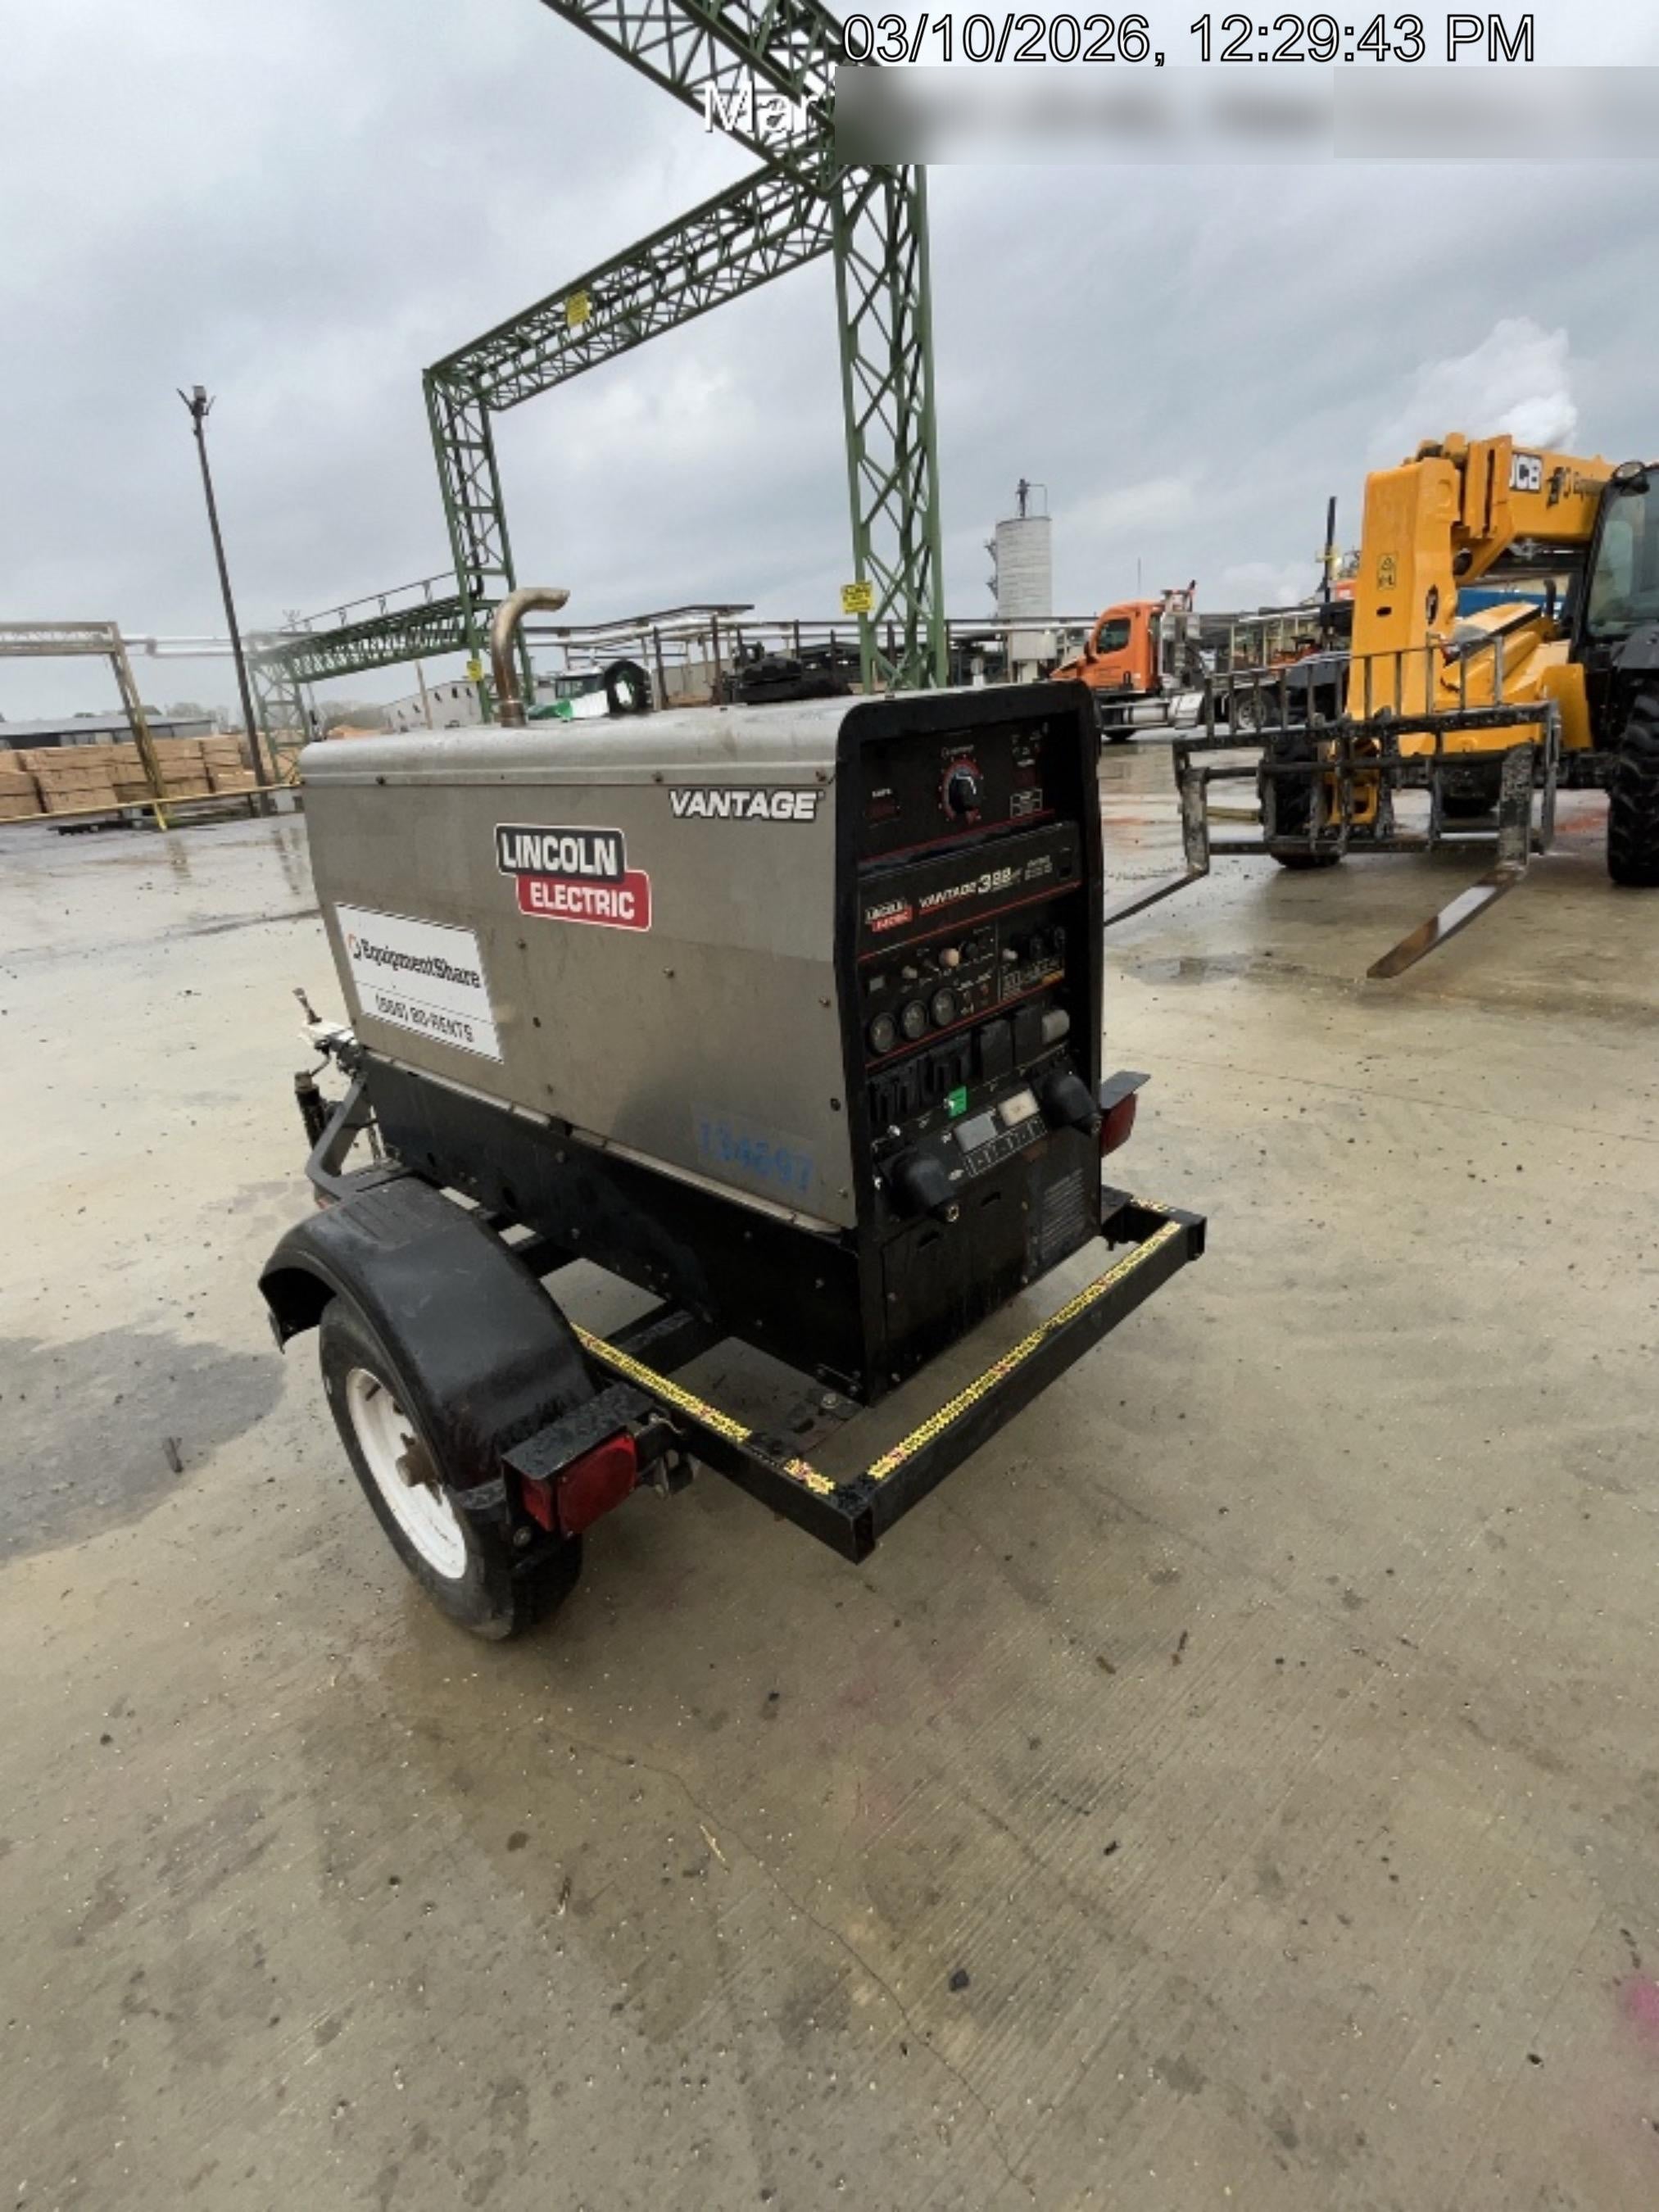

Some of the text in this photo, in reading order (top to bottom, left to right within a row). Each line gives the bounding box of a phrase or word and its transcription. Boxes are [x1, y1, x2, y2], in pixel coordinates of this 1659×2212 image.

[669, 789, 818, 821] VANTAGE
[501, 832, 619, 876] LINCOLN
[530, 882, 636, 920] ELECTRIC
[360, 938, 481, 989] EquipmentShare
